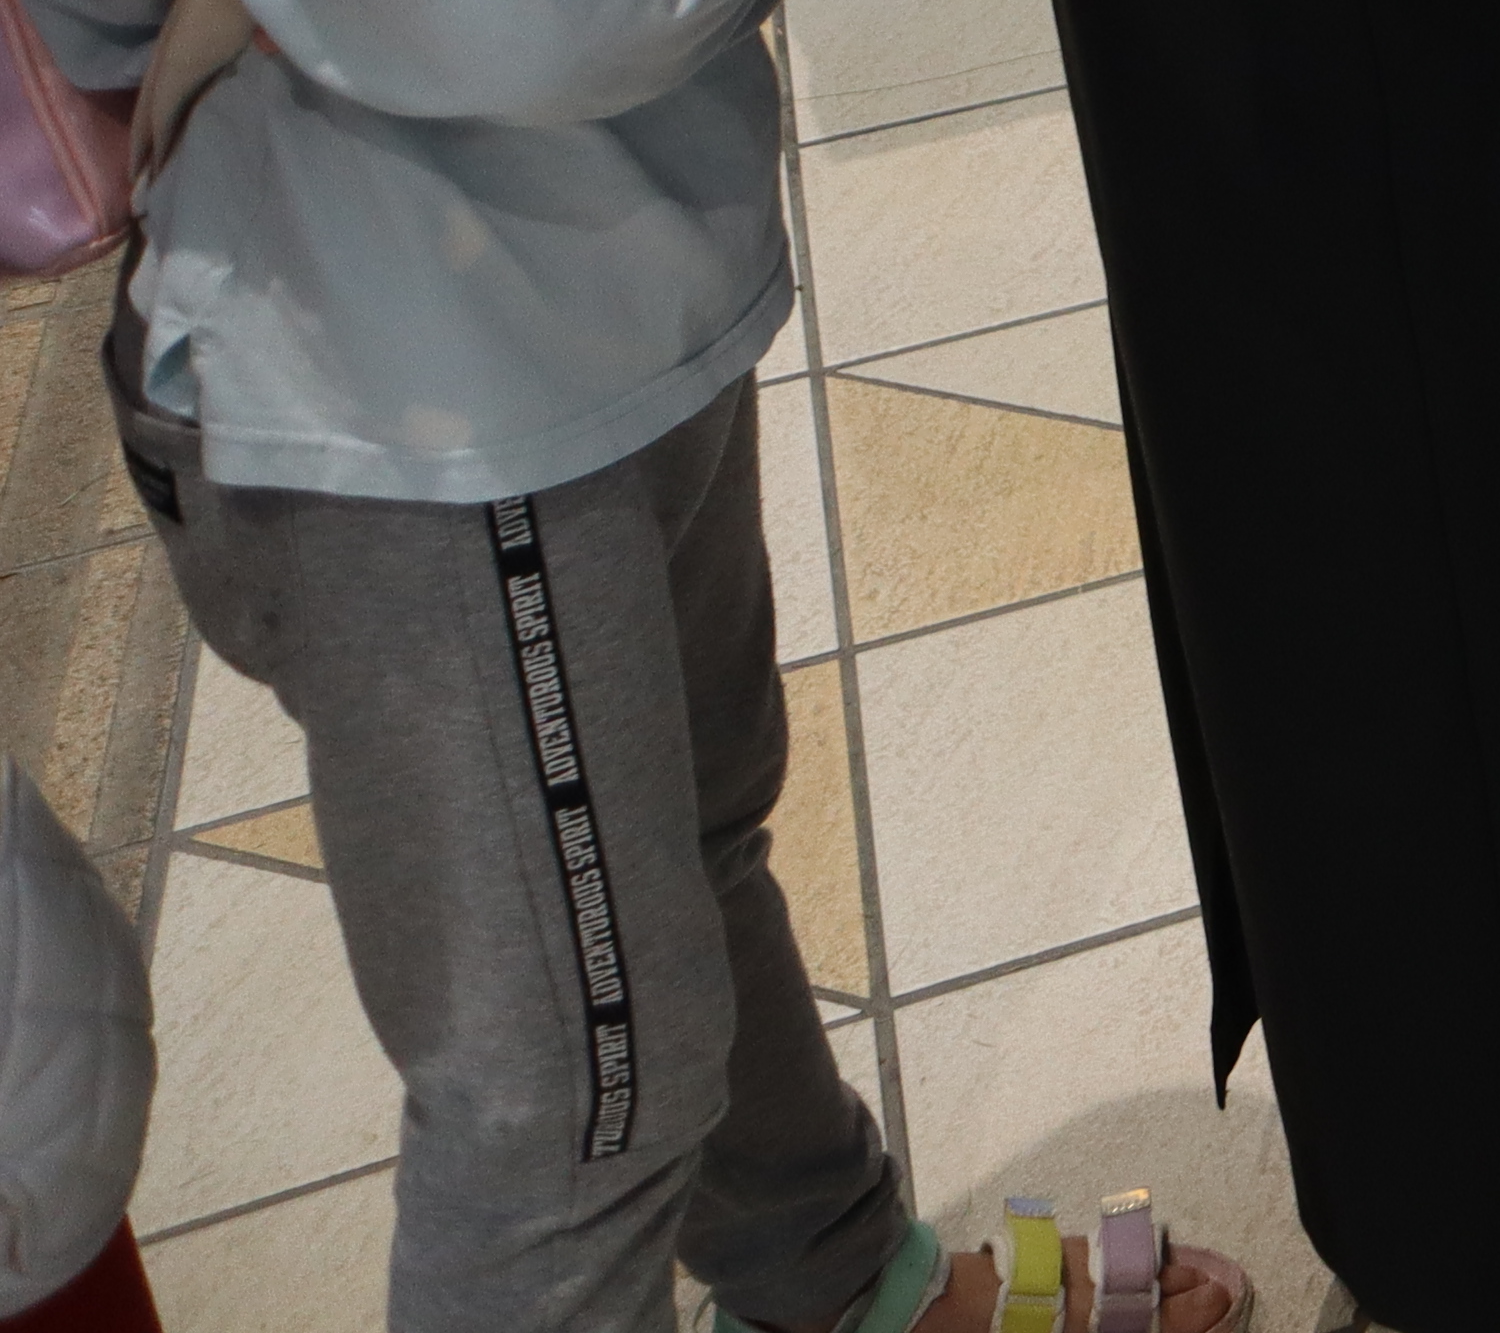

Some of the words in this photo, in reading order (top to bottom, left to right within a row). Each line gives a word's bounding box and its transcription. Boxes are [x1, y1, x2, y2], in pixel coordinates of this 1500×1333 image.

[508, 572, 549, 642] SPIRIT
[519, 640, 580, 786] ADVENTUROUS
[555, 805, 597, 871] SPIRIT
[571, 867, 624, 1007] ADVENTUROUS
[595, 1022, 630, 1086] SPIRIT
